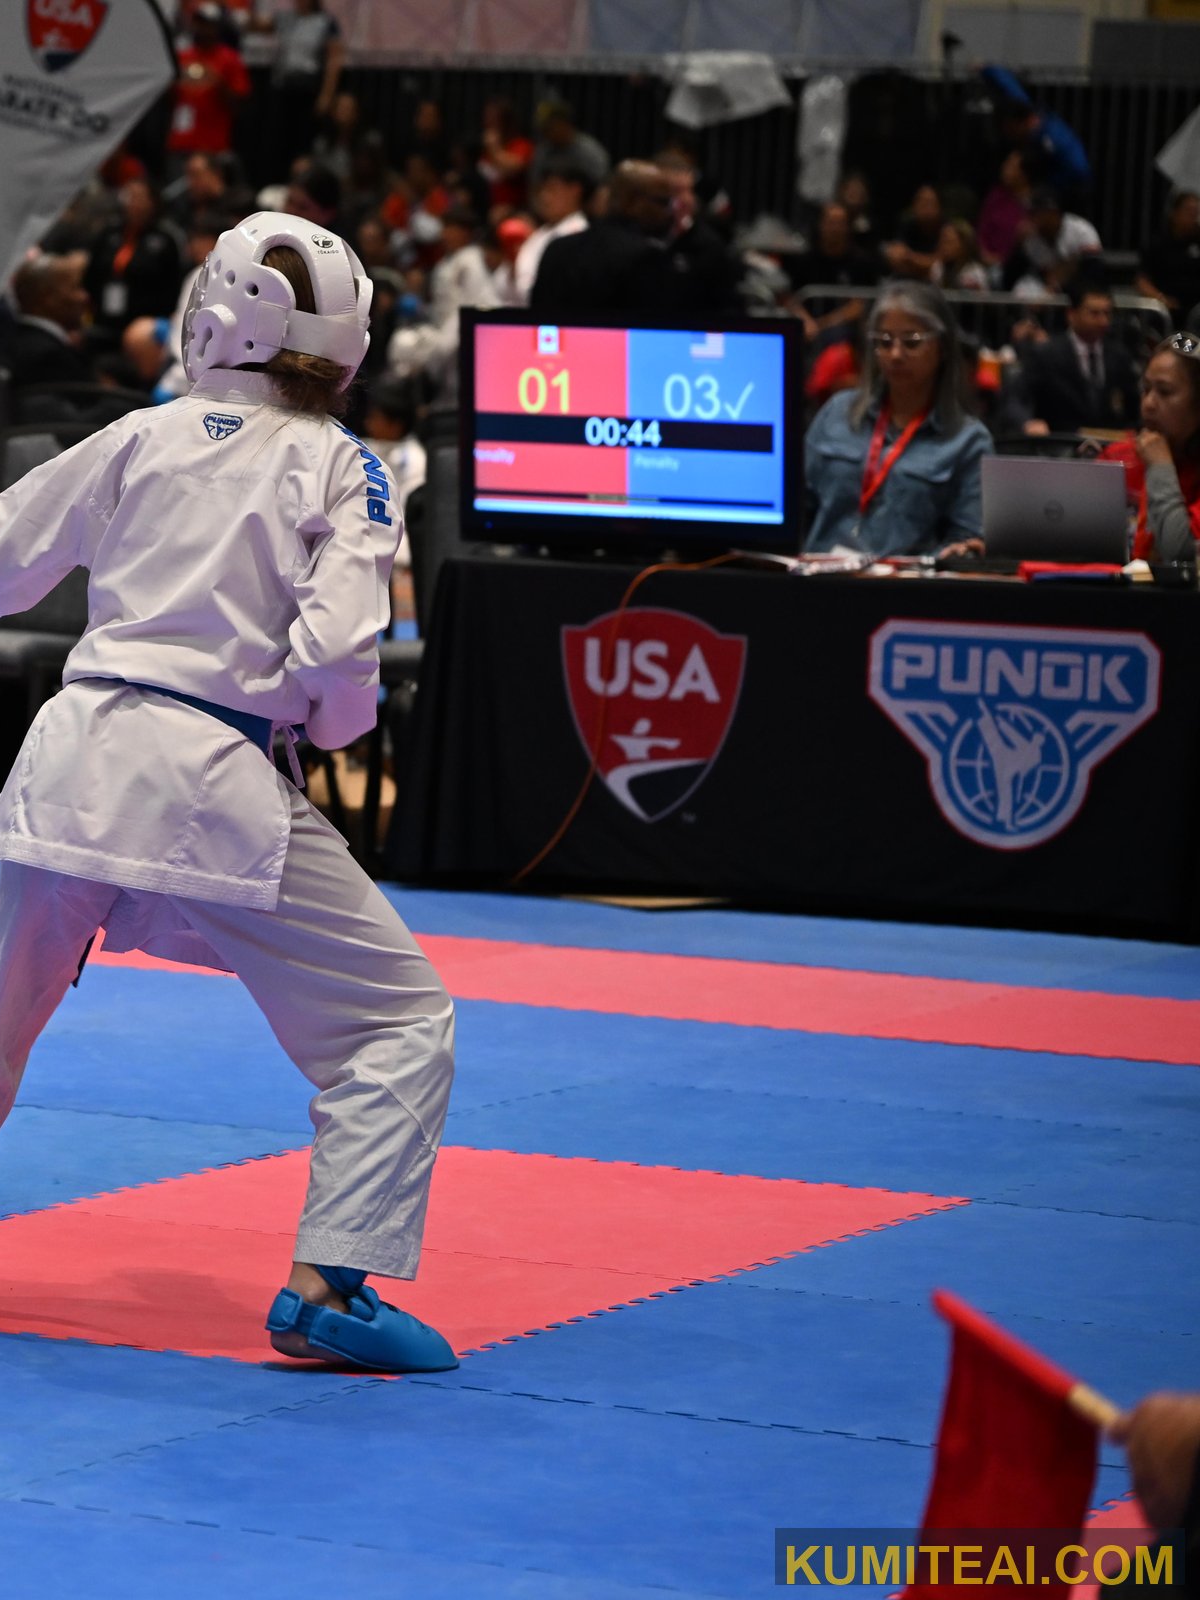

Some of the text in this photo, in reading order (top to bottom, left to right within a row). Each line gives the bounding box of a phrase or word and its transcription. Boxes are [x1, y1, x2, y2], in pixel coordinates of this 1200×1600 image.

[518, 367, 570, 414] 01
[663, 373, 721, 420] 03
[584, 416, 662, 448] 00:44
[584, 636, 721, 704] USA
[890, 643, 1135, 705] PUNOK
